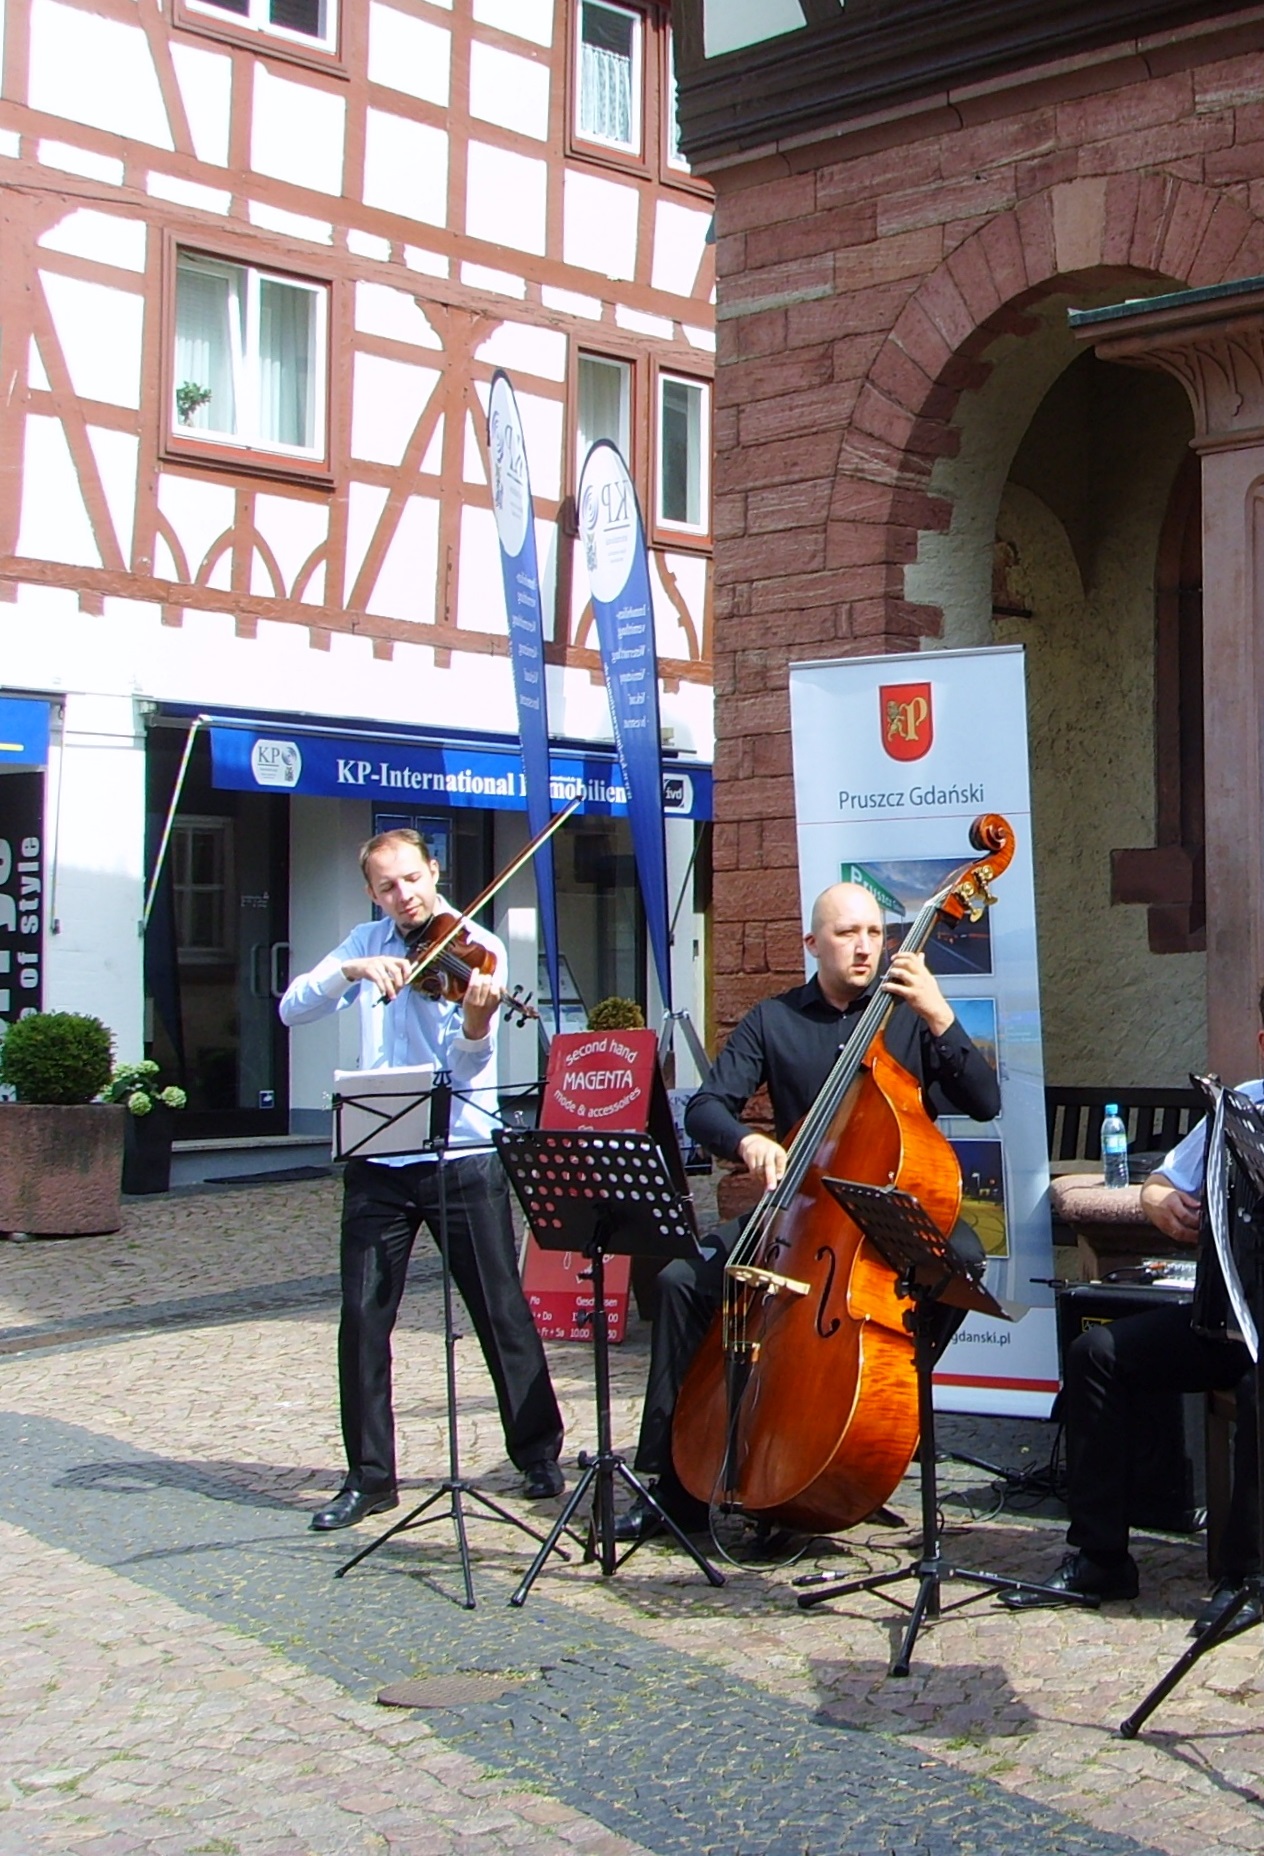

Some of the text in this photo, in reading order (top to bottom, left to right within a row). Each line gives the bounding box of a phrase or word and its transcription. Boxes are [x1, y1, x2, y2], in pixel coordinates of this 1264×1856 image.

[257, 746, 280, 763] KP
[336, 758, 627, 804] KP-International Imobilien
[838, 783, 985, 810] Pruszcz Gdański
[17, 836, 42, 935] style
[17, 952, 39, 989] of
[565, 1038, 638, 1066] second hand
[562, 1069, 633, 1091] MAGENTA
[553, 1089, 576, 1113] mode
[587, 1087, 642, 1118] accessoires
